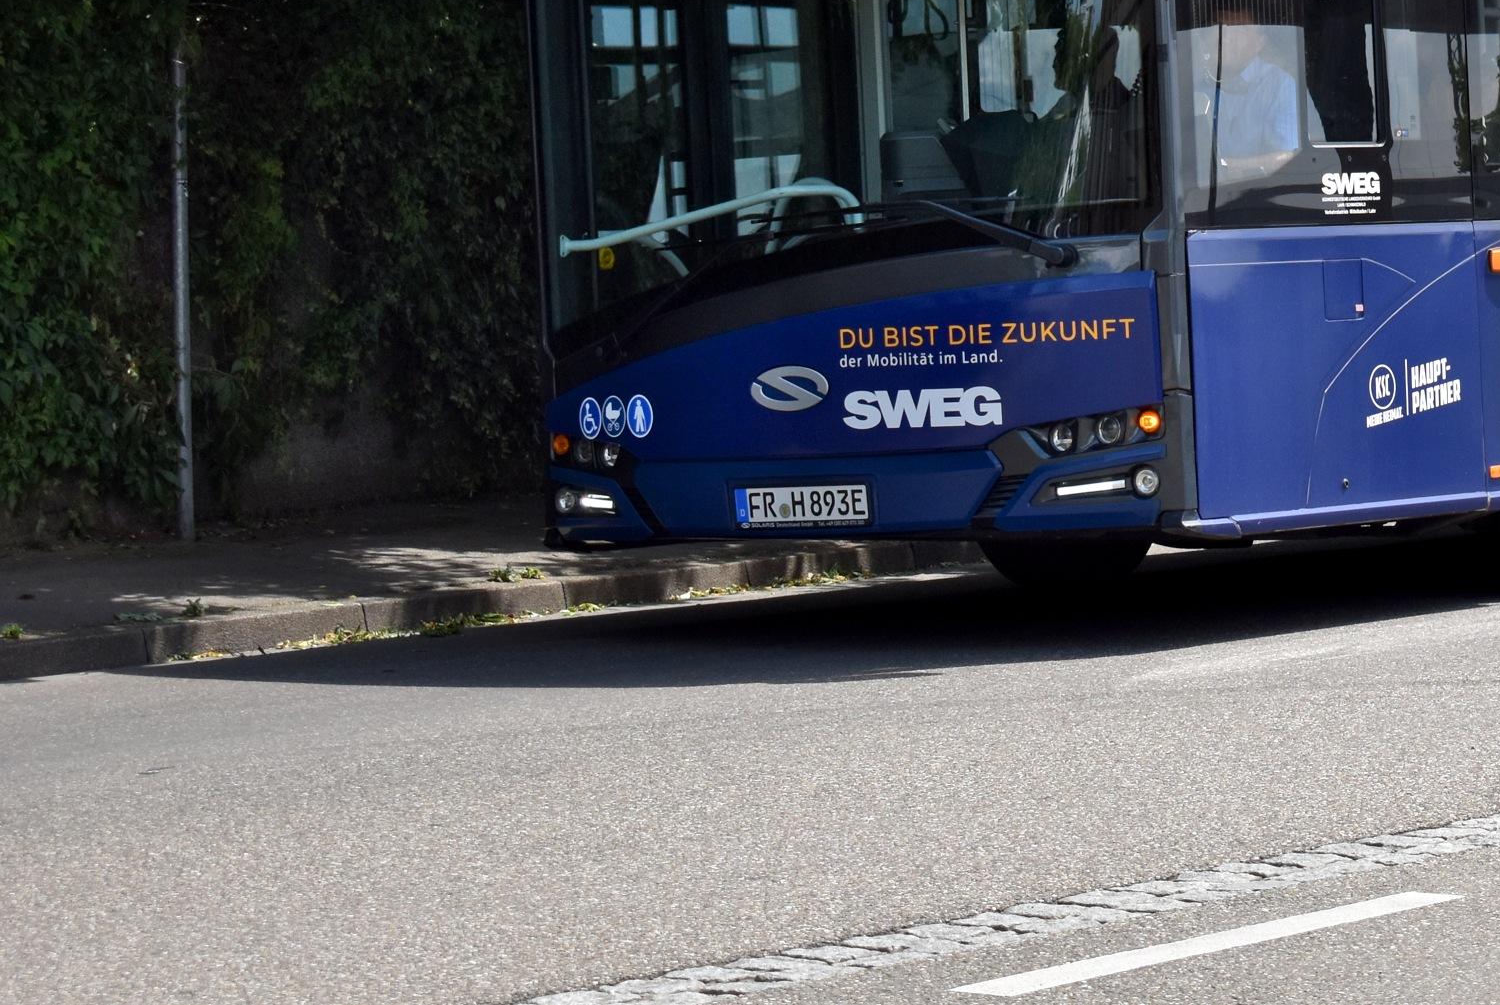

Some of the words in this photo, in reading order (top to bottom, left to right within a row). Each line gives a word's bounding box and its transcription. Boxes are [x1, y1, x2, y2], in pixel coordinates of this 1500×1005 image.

[1321, 171, 1381, 195] SWEG
[839, 327, 874, 348] DU
[883, 325, 939, 347] BIST
[948, 323, 992, 345] DIE
[1001, 318, 1135, 344] ZUKUNFT
[839, 354, 862, 368] der
[867, 351, 934, 367] Mobilität
[939, 351, 956, 364] im
[961, 349, 1003, 364] Land.
[1410, 357, 1451, 389] HAUPT-
[1375, 373, 1391, 400] KSC
[1411, 379, 1461, 414] PARTNER
[842, 385, 1003, 430] SWEG
[740, 509, 746, 517] D
[748, 491, 778, 518] FR
[809, 489, 866, 517] 893E
